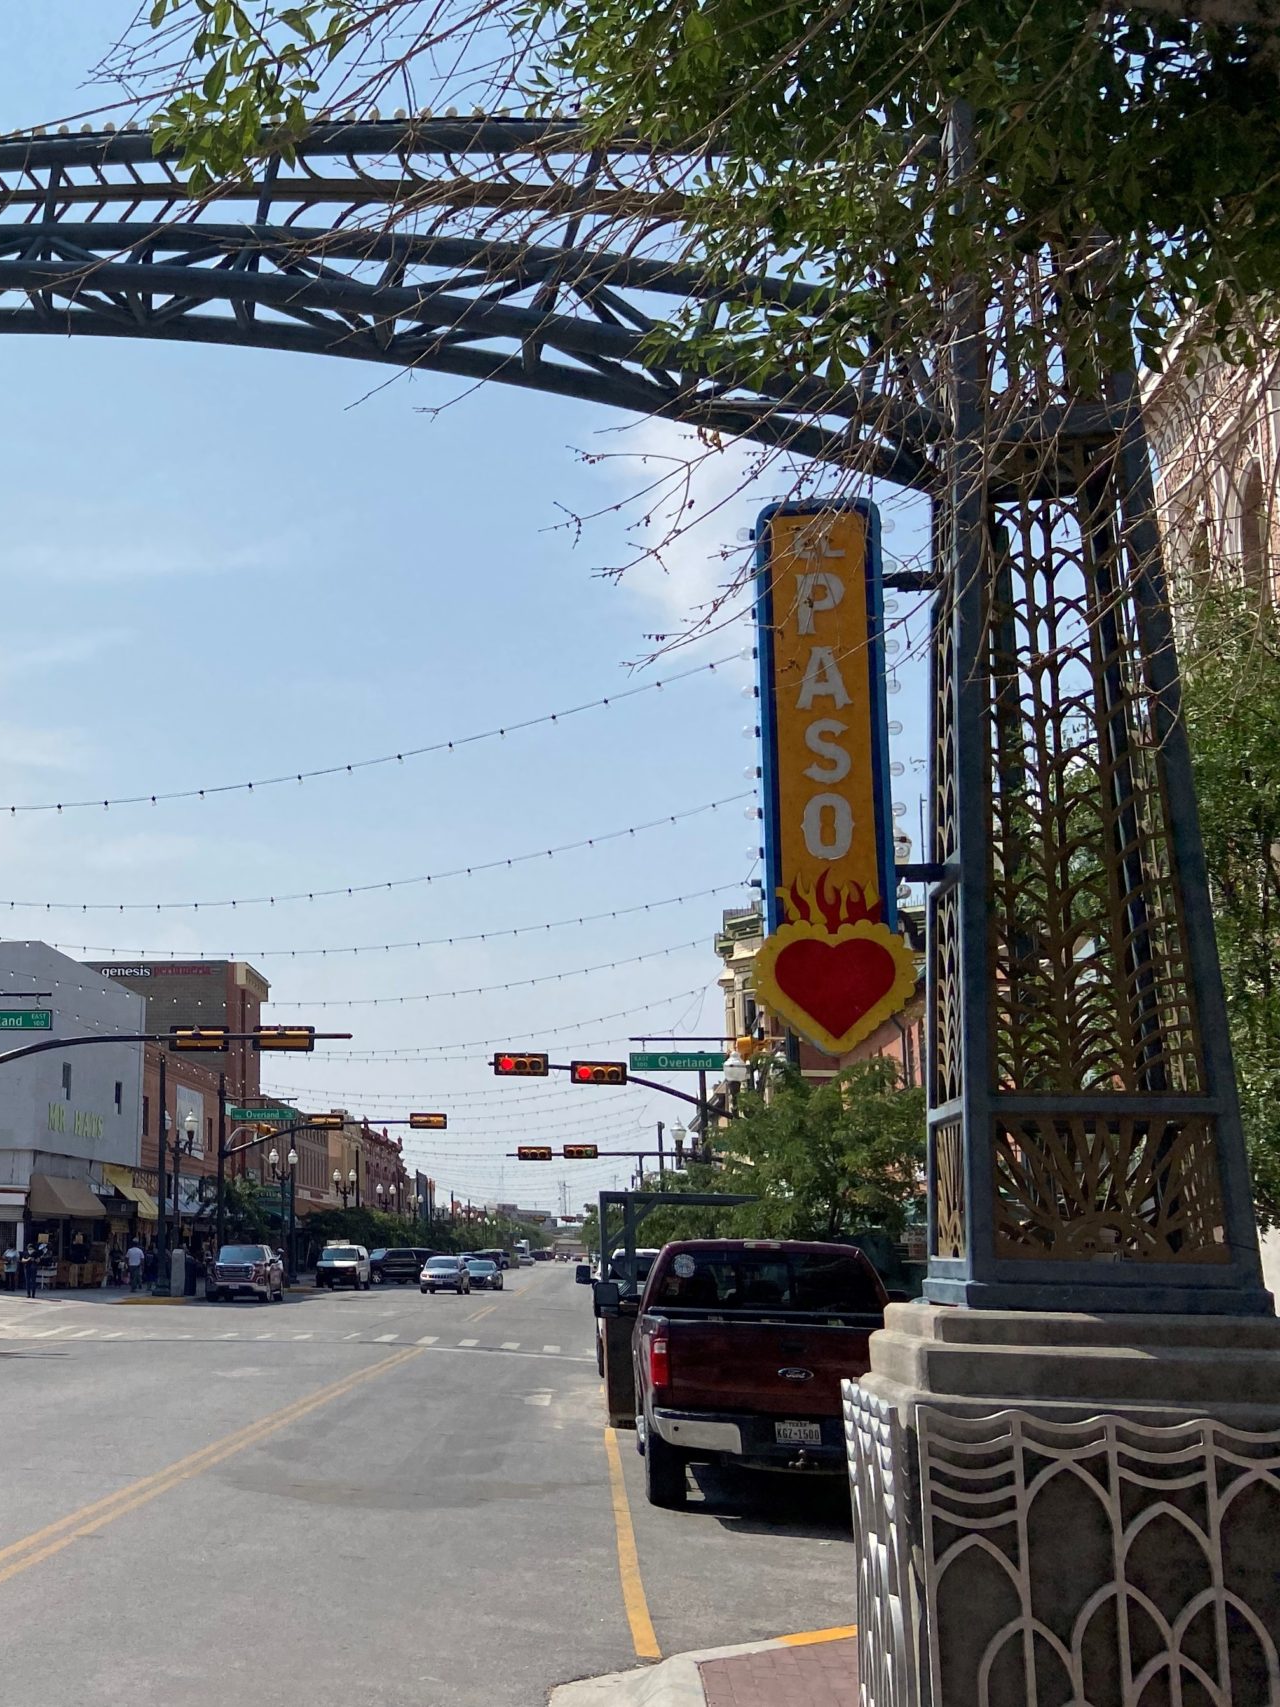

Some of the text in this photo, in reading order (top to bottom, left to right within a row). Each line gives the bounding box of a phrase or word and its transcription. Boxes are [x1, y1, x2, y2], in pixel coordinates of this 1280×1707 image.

[795, 573, 855, 861] PASO
[101, 964, 151, 977] genesis
[658, 1056, 712, 1068] Overland
[246, 1109, 280, 1118] Overland
